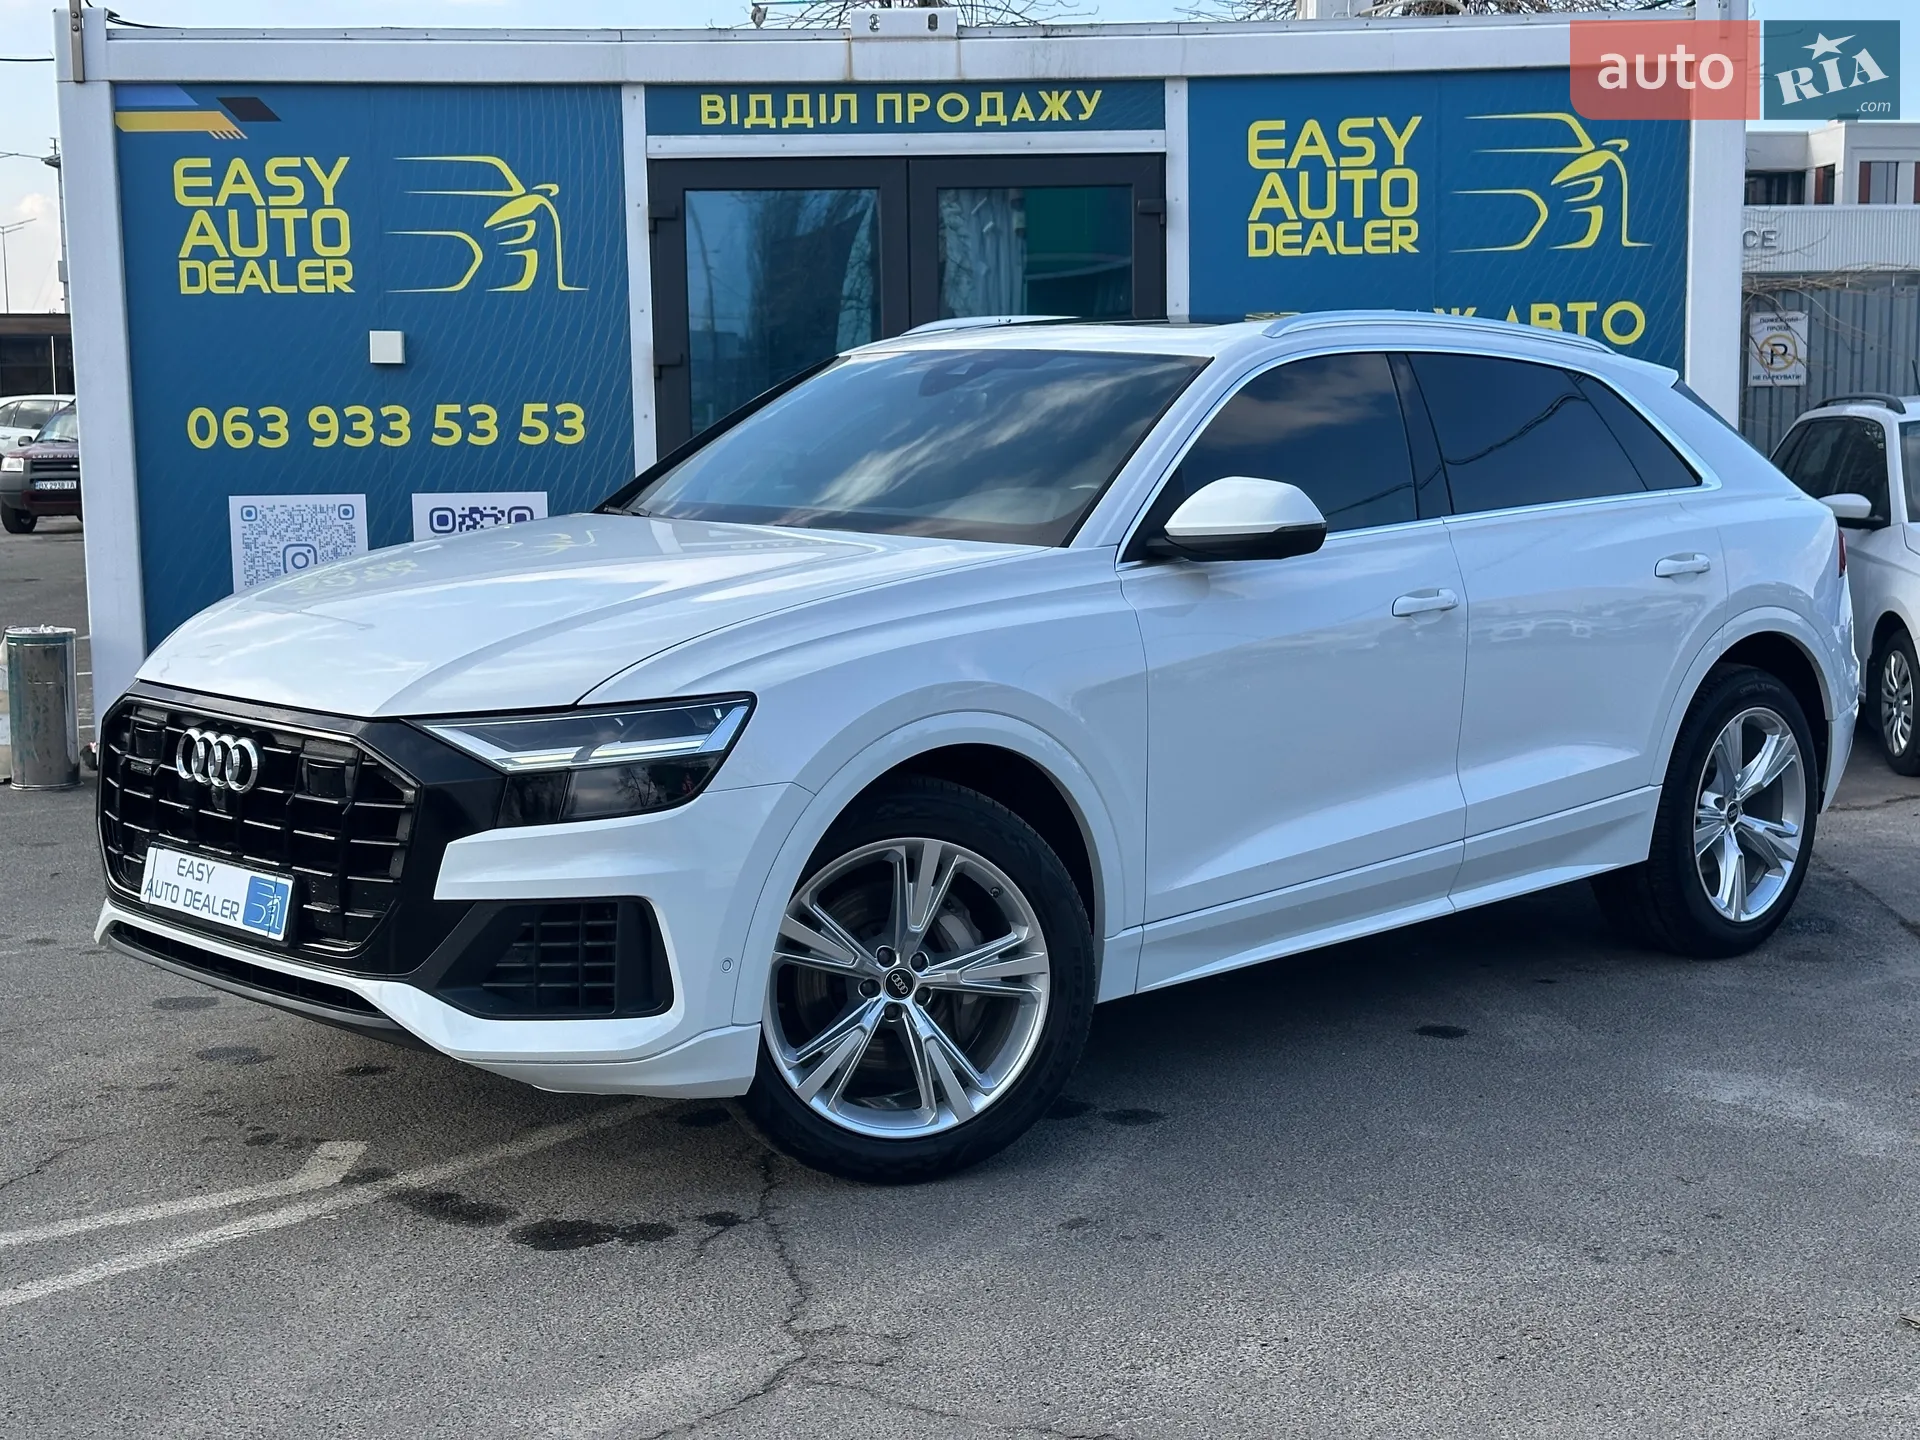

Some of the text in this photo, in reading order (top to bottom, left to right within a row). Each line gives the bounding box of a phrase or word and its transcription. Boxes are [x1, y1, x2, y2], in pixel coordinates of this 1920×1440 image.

[701, 89, 1103, 128] ВІДДІЛ ПРОДАЖУ
[1247, 115, 1423, 168] EASY
[173, 156, 350, 206] EASY
[1249, 168, 1418, 220] AUTO
[179, 208, 351, 257] AUTO
[1247, 218, 1419, 257] DEALER
[179, 258, 355, 295] DEALER
[187, 402, 587, 449] 063 933 53 53
[176, 857, 216, 884] EASY
[143, 877, 240, 922] AUTO DEALER
